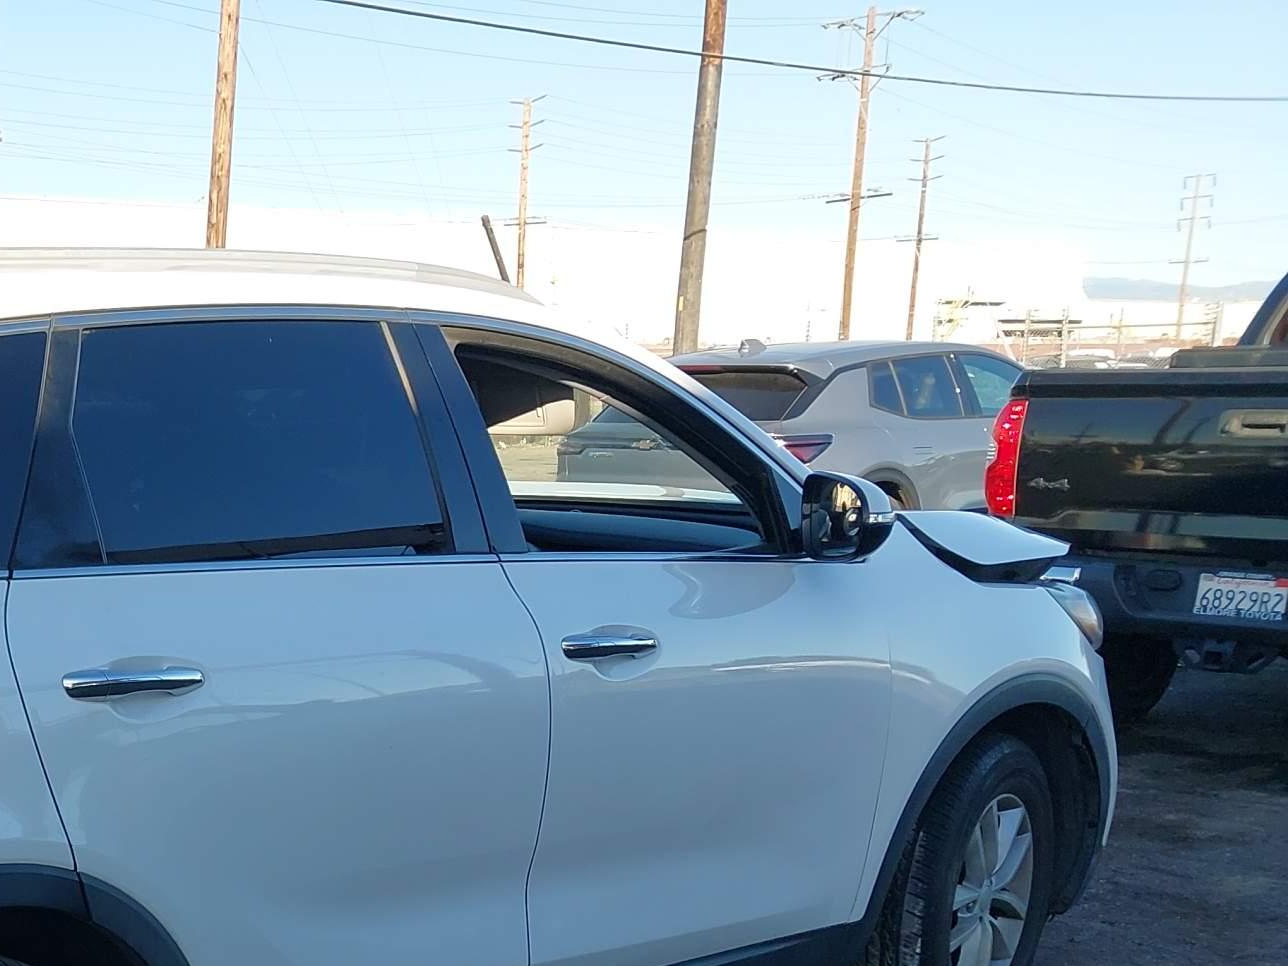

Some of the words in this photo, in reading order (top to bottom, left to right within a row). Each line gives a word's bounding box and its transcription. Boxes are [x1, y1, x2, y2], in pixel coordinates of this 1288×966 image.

[1199, 588, 1284, 613] 68929R2
[1193, 607, 1238, 617] ELMORE
[1239, 610, 1282, 620] TOYOTA
